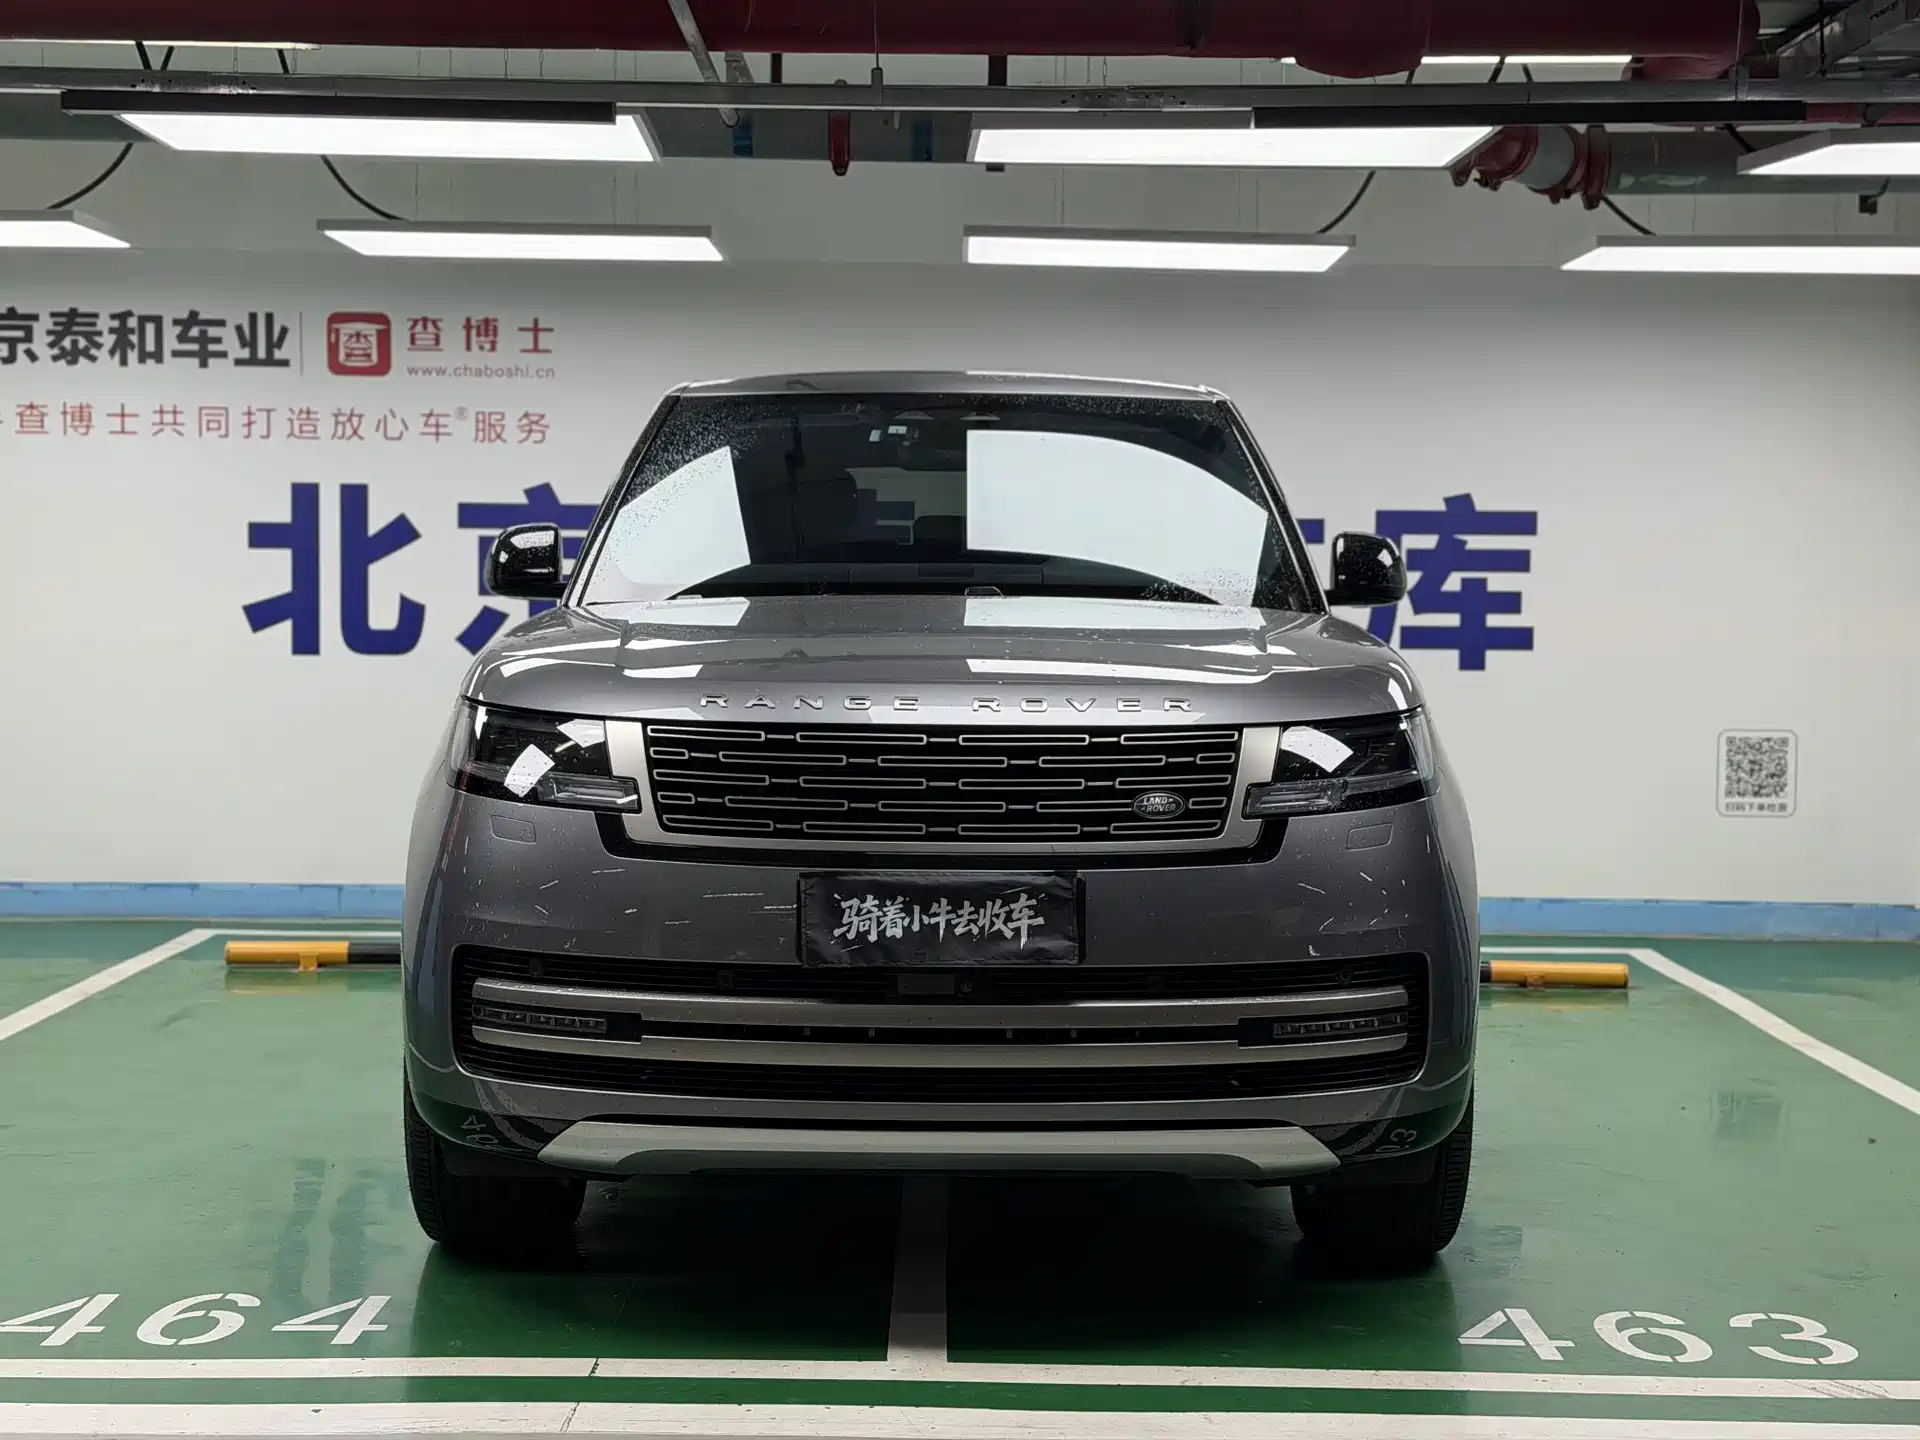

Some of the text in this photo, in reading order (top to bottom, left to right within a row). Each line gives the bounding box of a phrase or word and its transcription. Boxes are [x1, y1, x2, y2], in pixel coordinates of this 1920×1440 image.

[406, 315, 555, 354] 查博士
[406, 364, 556, 379] www.chaboshi.cn
[700, 693, 1193, 713] RANGE ROVER
[1143, 796, 1168, 805] LAND
[1146, 803, 1176, 813] ROVER
[832, 893, 1045, 950] 骑着小牛去收车
[0, 1293, 392, 1346] 464
[1457, 1308, 1860, 1365] 463
